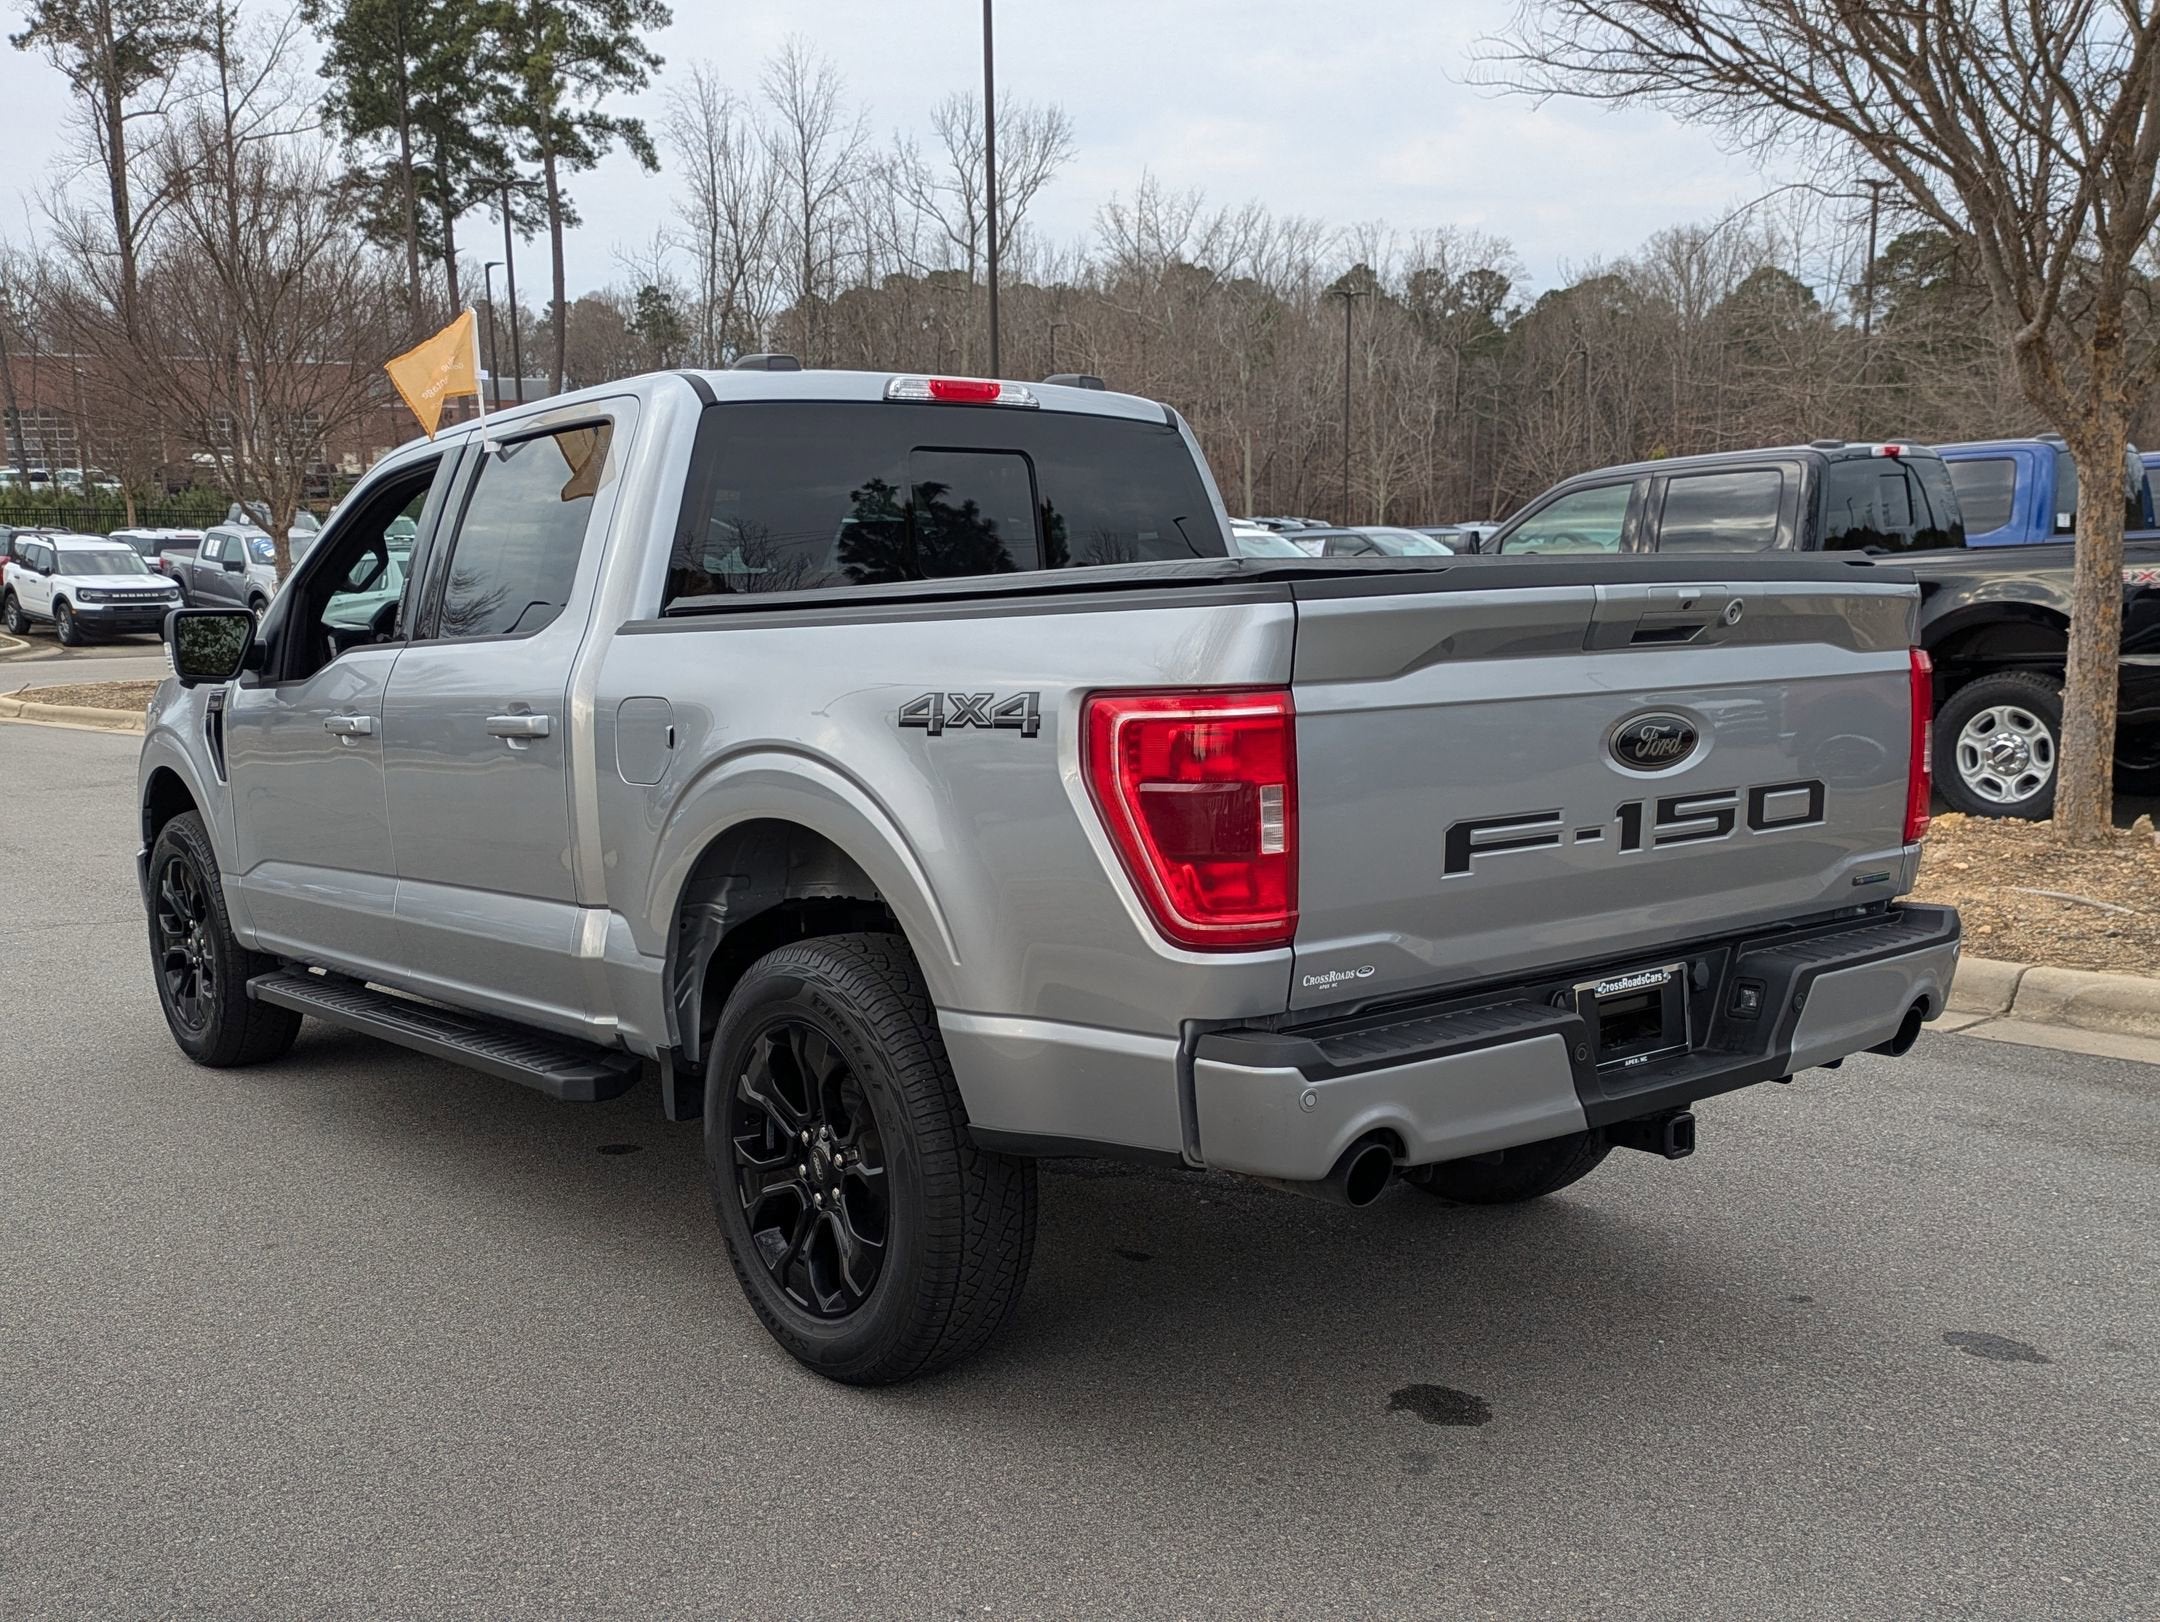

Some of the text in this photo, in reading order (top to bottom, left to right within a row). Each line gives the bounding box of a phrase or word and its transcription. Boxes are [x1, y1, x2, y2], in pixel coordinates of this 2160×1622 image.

[1635, 725, 1682, 758] Ford
[1443, 779, 1826, 878] F-150
[1599, 972, 1663, 994] CrossRoadsCars
